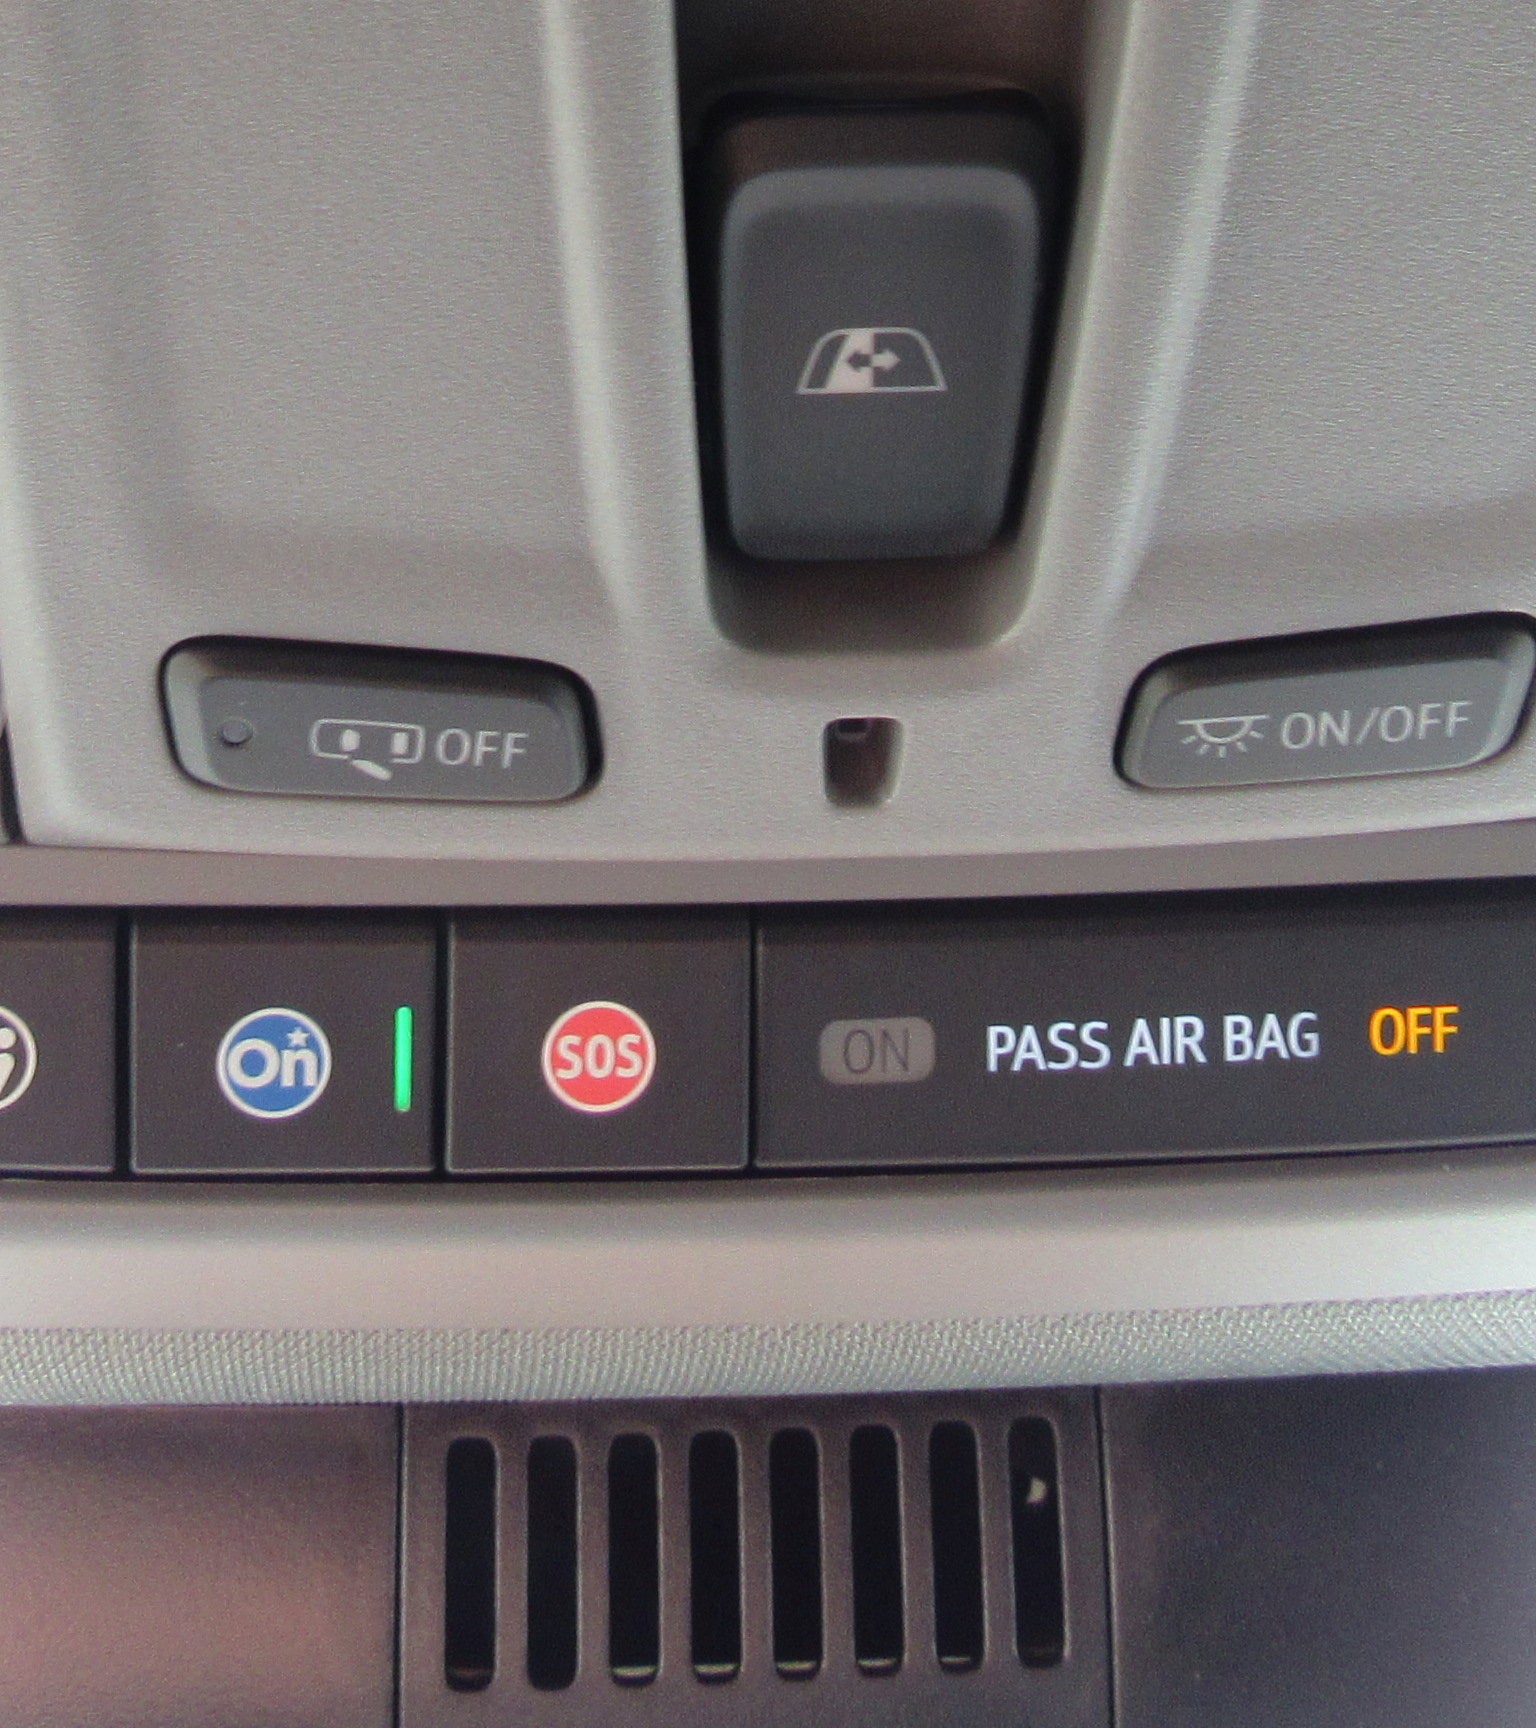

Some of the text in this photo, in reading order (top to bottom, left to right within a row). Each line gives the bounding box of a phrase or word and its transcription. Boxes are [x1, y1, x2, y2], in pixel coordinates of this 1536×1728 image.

[1281, 700, 1472, 749] ON/OFF
[436, 729, 528, 768] OFF
[558, 1034, 643, 1080] SOS
[843, 1029, 908, 1074] ON
[986, 1005, 1459, 1072] PASS AIR BAG OFF
[227, 1037, 320, 1088] On
